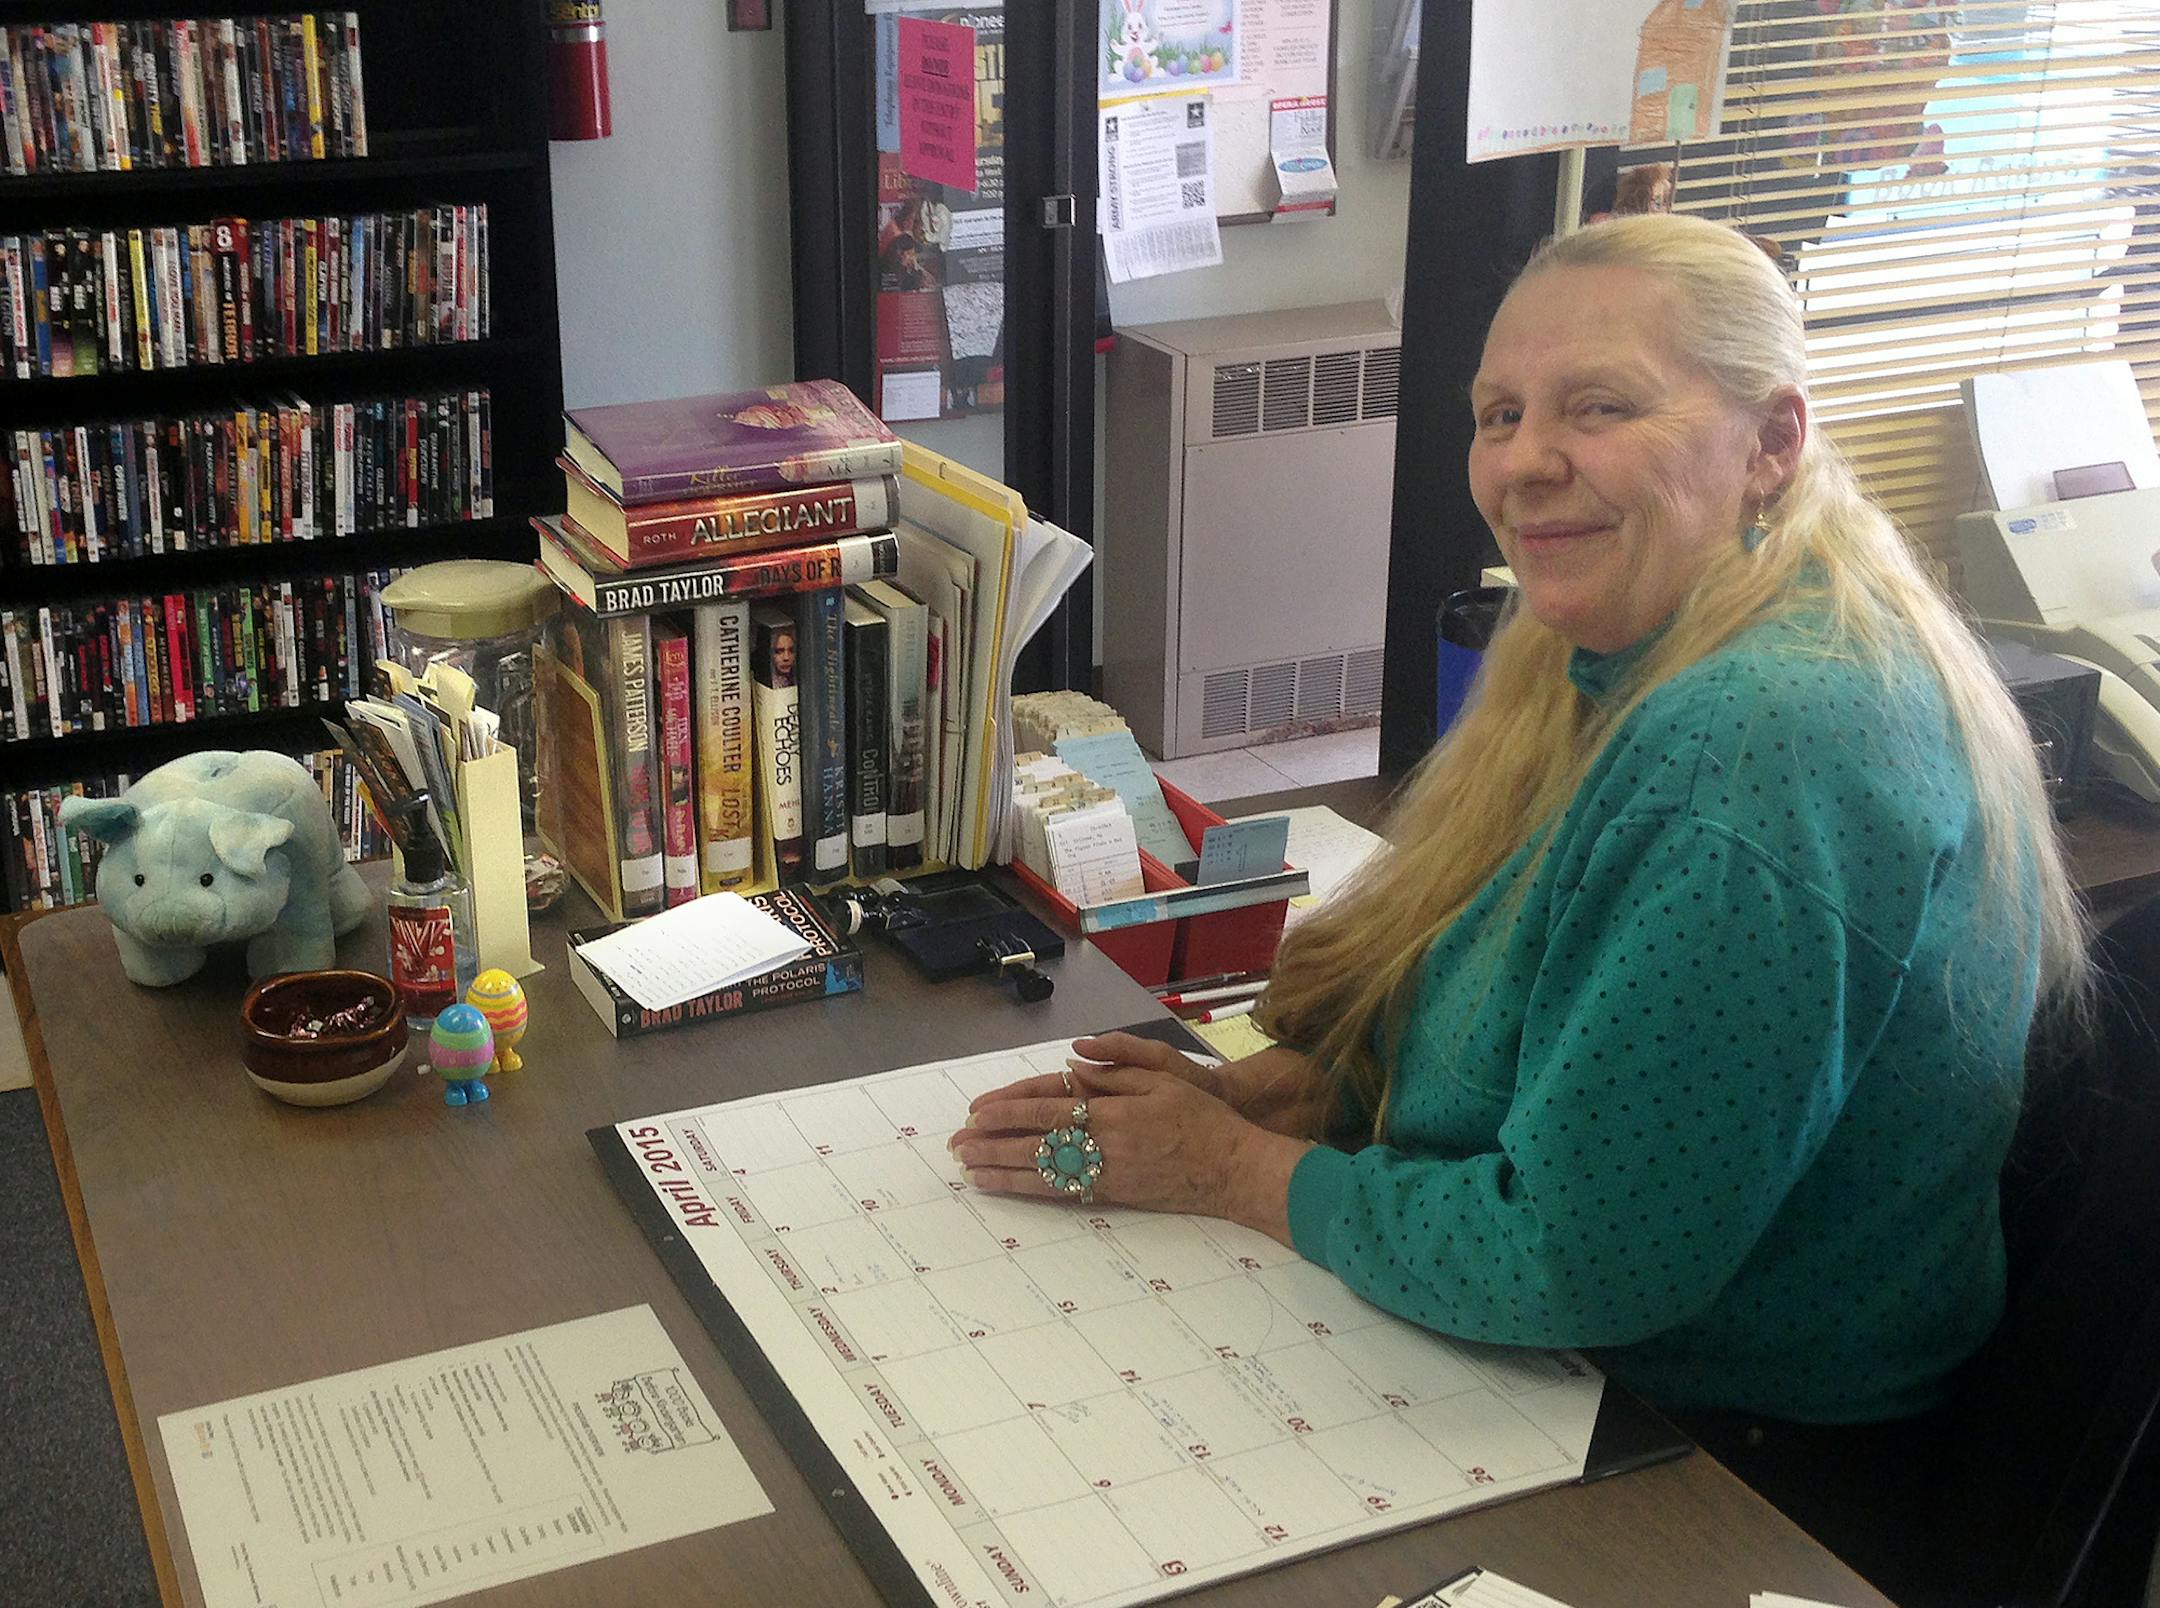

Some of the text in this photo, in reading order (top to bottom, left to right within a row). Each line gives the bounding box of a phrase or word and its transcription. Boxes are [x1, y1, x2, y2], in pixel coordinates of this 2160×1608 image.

[690, 496, 854, 546] ALLEGIANT
[643, 532, 677, 545] ROTH
[759, 566, 802, 586] DAYS
[806, 562, 826, 581] OF
[606, 575, 724, 612] BRAD TAYLOR
[621, 632, 648, 752] JAMES PATTERSON
[720, 615, 742, 774] CATHERINE COULTER
[774, 716, 792, 786] ECHOES
[722, 789, 740, 828] LOST
[823, 767, 834, 834] HANNA
[772, 963, 826, 980] POLARIS
[752, 977, 820, 998] PROTOCOL
[688, 991, 743, 1018] TAYLOR
[901, 1126, 918, 1137] 18
[681, 1128, 717, 1172] SATURDAY
[815, 1144, 833, 1156] 11
[628, 1126, 719, 1228] April 2015
[949, 1181, 967, 1192] 17
[725, 1196, 754, 1223] FRIDAY
[861, 1199, 880, 1211] 10
[1089, 1217, 1111, 1230] 23
[1001, 1237, 1020, 1250] 16
[764, 1249, 804, 1290] THURSDAY
[1239, 1257, 1262, 1271] 29
[821, 1286, 839, 1295] 2
[1149, 1278, 1172, 1293] 22
[1057, 1300, 1078, 1313] 15
[807, 1305, 857, 1362] WEDNESDAY
[969, 1330, 985, 1338] 8
[1307, 1321, 1332, 1336] 28
[1215, 1345, 1240, 1360] 21
[1120, 1369, 1142, 1384] 14
[864, 1383, 905, 1428] TUESDAY
[1027, 1402, 1046, 1410] 7
[1382, 1393, 1410, 1409] 27
[1287, 1417, 1313, 1434] 20
[1188, 1444, 1211, 1460] 13
[920, 1459, 965, 1506] MONDAY
[1093, 1479, 1111, 1488] 6
[1467, 1467, 1496, 1484] 26
[1366, 1496, 1392, 1512] 19
[1264, 1524, 1290, 1542] 12
[984, 1545, 1029, 1594] SUNDAY
[1161, 1560, 1187, 1575] 5
